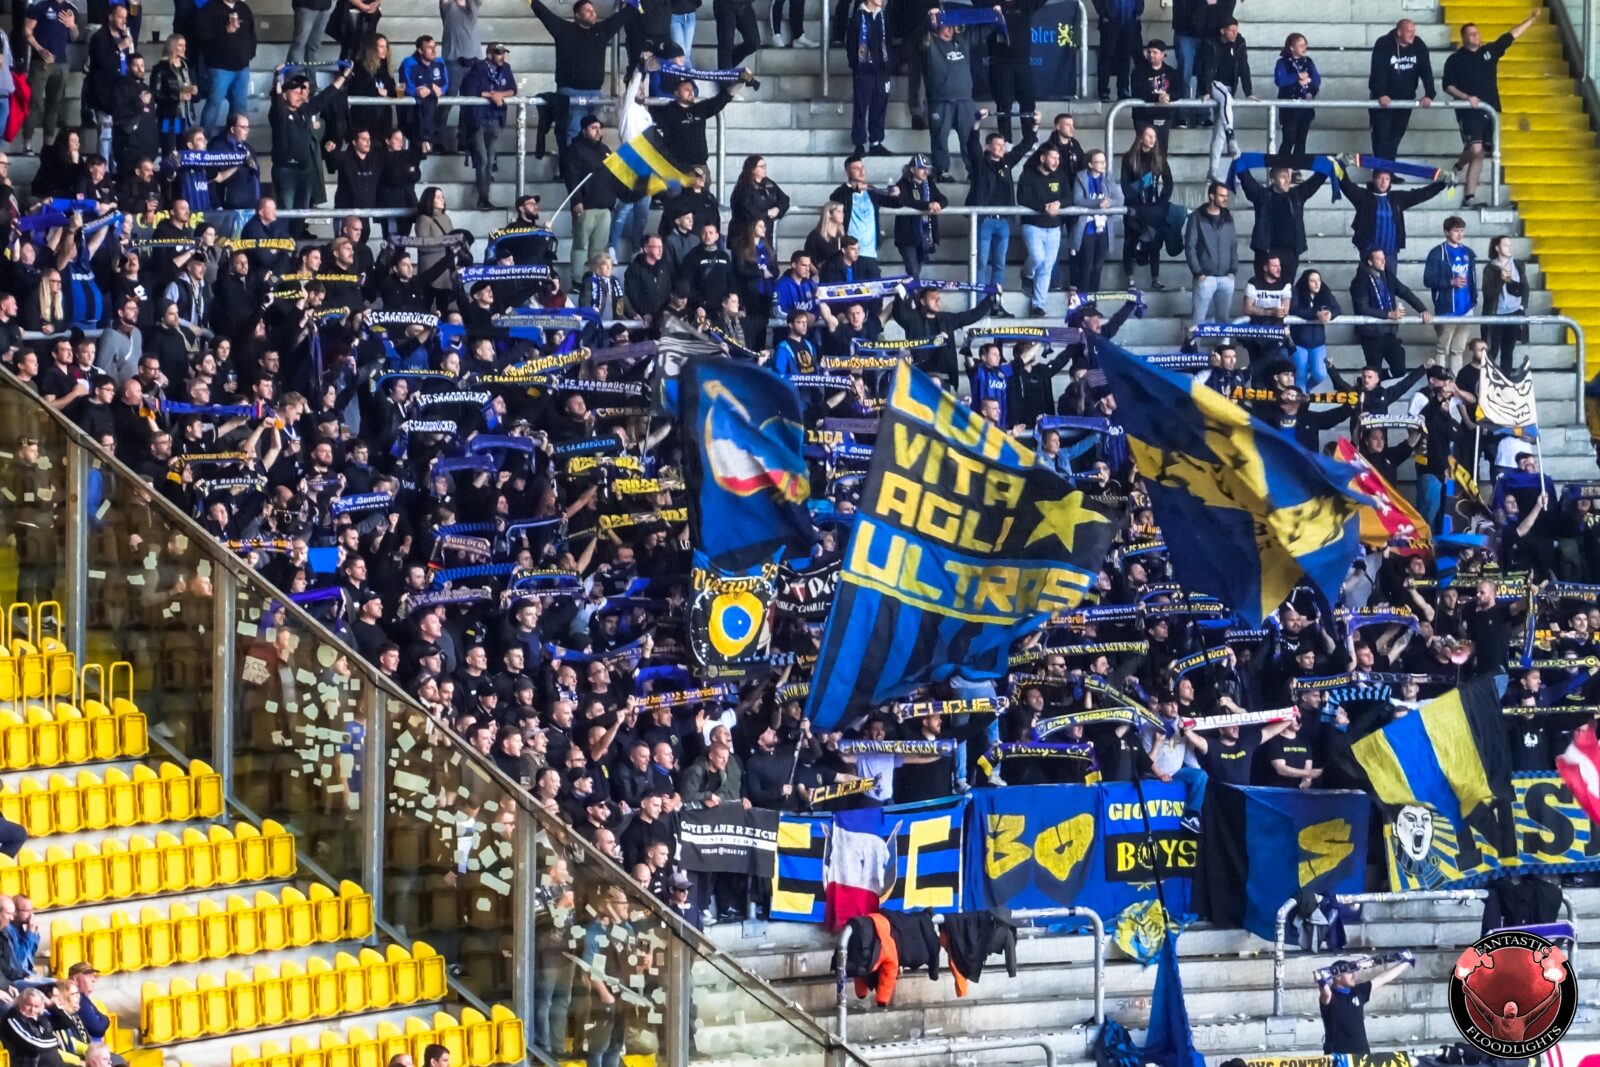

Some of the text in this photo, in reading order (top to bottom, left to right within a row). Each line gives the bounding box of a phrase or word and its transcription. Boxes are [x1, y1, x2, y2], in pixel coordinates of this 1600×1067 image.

[1030, 27, 1055, 44] dler
[893, 422, 1026, 509] VITA
[875, 470, 1014, 553] AGLI
[849, 520, 1091, 613] ULTRAS
[1108, 799, 1185, 821] GIOVEN
